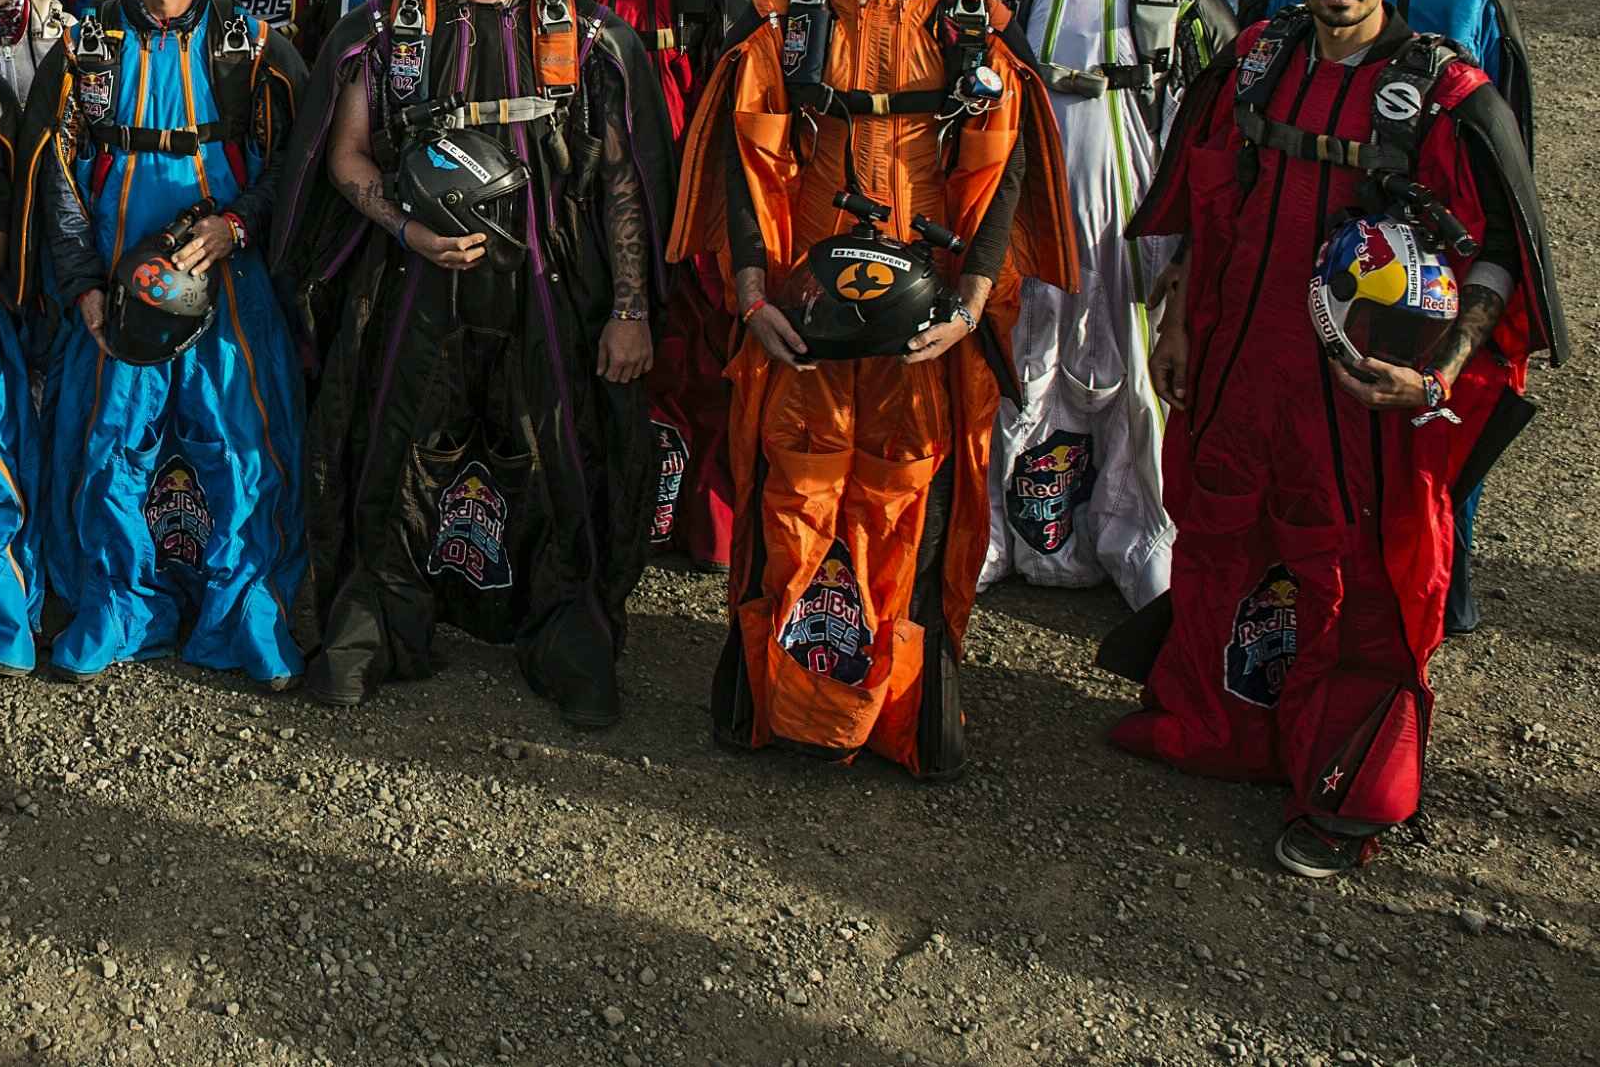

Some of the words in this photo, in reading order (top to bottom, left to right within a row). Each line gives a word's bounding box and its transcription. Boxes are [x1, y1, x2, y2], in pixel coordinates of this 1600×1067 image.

[457, 151, 489, 181] JORDAN
[859, 251, 908, 269] SCHWERY
[1406, 243, 1419, 304] WALTENSPIEL
[1311, 277, 1326, 314] Red
[1423, 296, 1446, 310] Red
[1317, 313, 1342, 344] Bull
[1017, 472, 1067, 497] Red
[1019, 496, 1069, 522] AC
[441, 539, 485, 581] 02
[784, 613, 861, 655] ACES
[1238, 607, 1283, 648] Red
